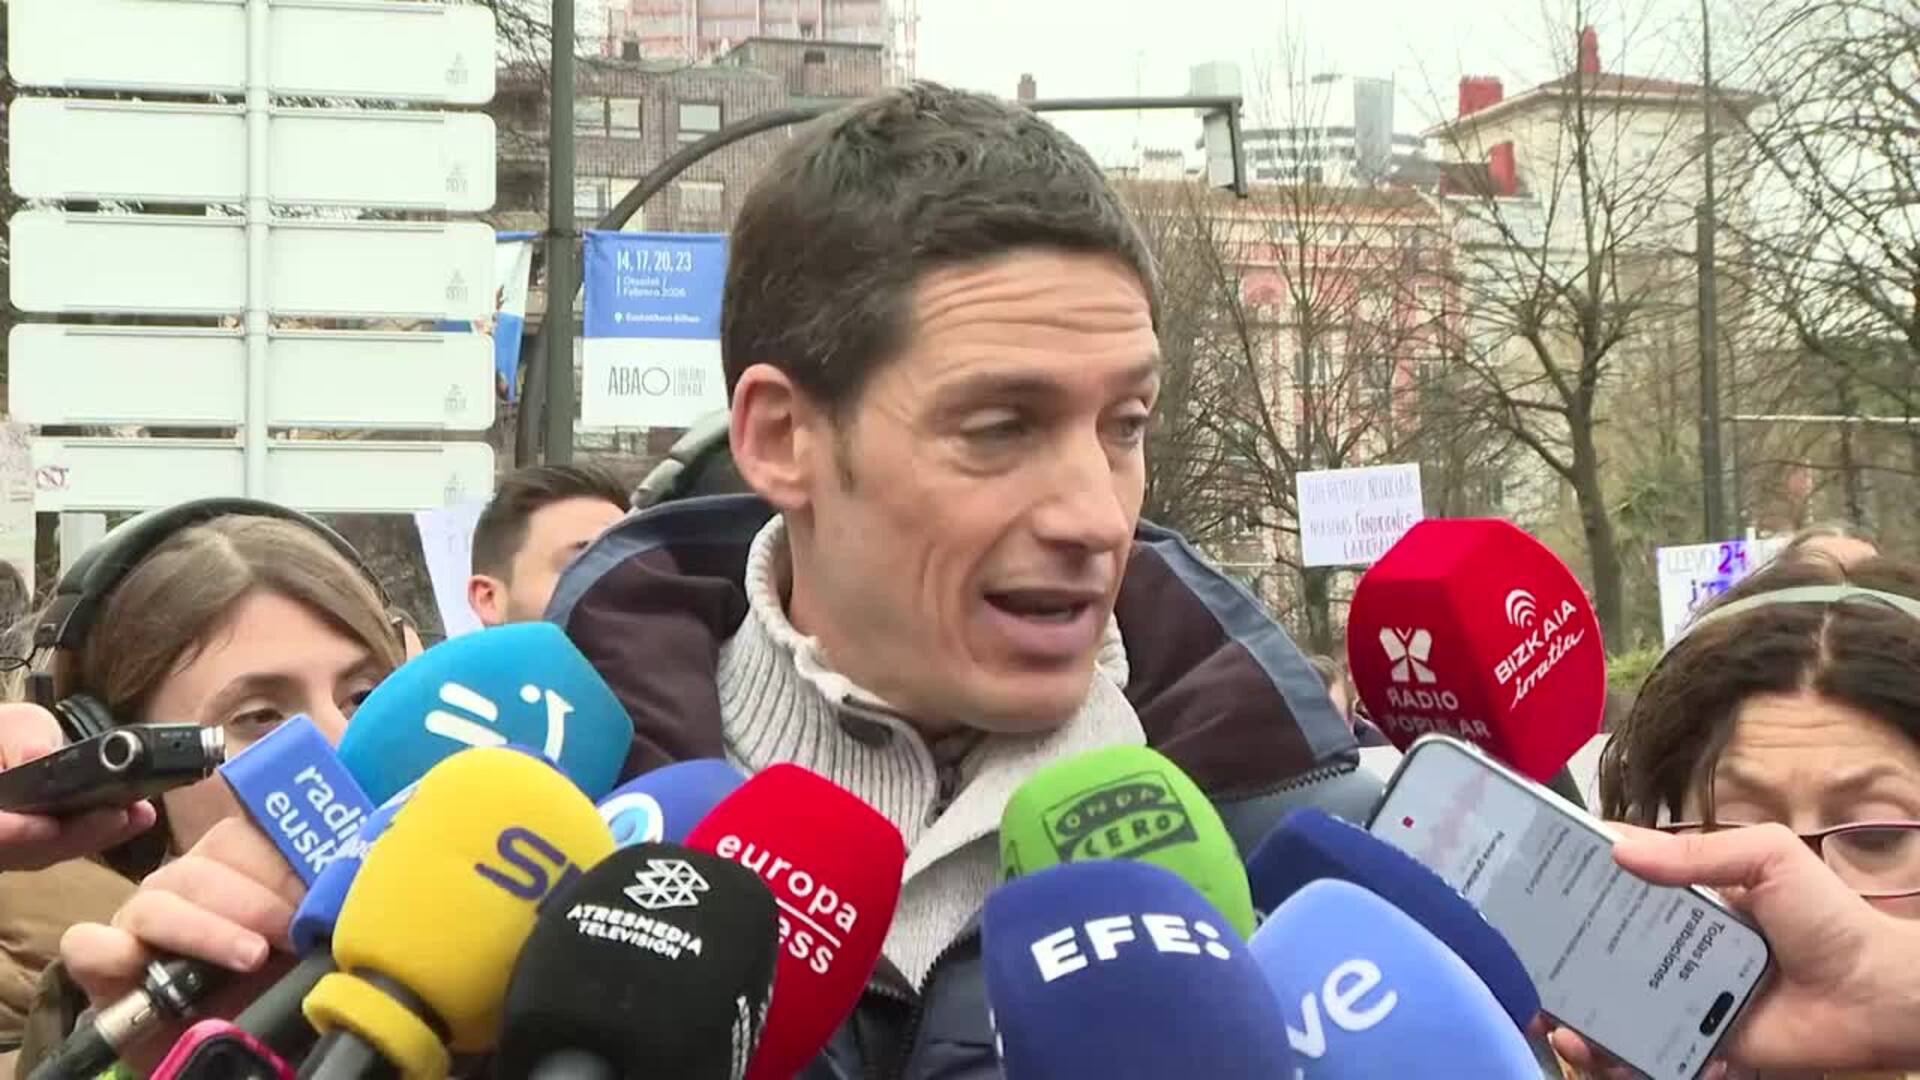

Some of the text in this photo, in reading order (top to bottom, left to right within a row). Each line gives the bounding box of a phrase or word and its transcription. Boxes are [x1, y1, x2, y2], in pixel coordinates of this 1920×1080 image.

[654, 249, 674, 274] 20,
[676, 249, 693, 274] 23
[607, 364, 671, 397] ABAO
[1717, 541, 1748, 575] 24
[1494, 599, 1577, 685] BIZKAIA
[1509, 627, 1585, 713] irratia
[1386, 687, 1459, 711] RADIO
[293, 764, 369, 842] radi
[1063, 787, 1158, 830] ONDA
[1083, 813, 1172, 858] CERO
[715, 834, 858, 935] europa
[566, 902, 704, 957] ATRESMEDIA
[577, 919, 682, 960] TELEVISIÓN
[1648, 906, 1705, 991] grabaciones
[1677, 918, 1726, 984] Todas las
